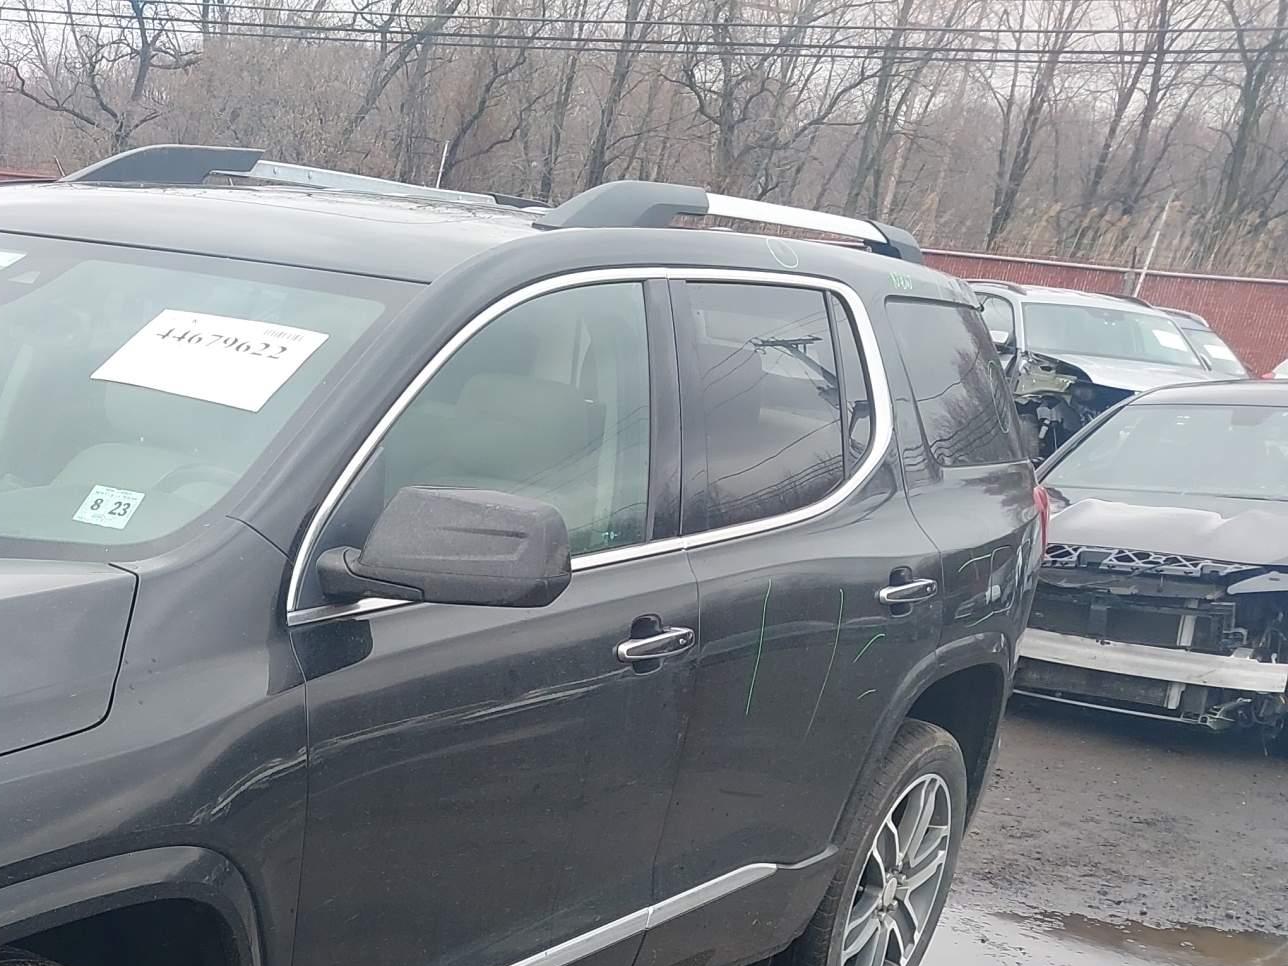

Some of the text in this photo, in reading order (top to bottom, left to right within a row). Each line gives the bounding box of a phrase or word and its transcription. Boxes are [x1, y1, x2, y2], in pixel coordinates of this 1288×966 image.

[156, 327, 288, 359] 44679622
[90, 498, 131, 516] 8 23
